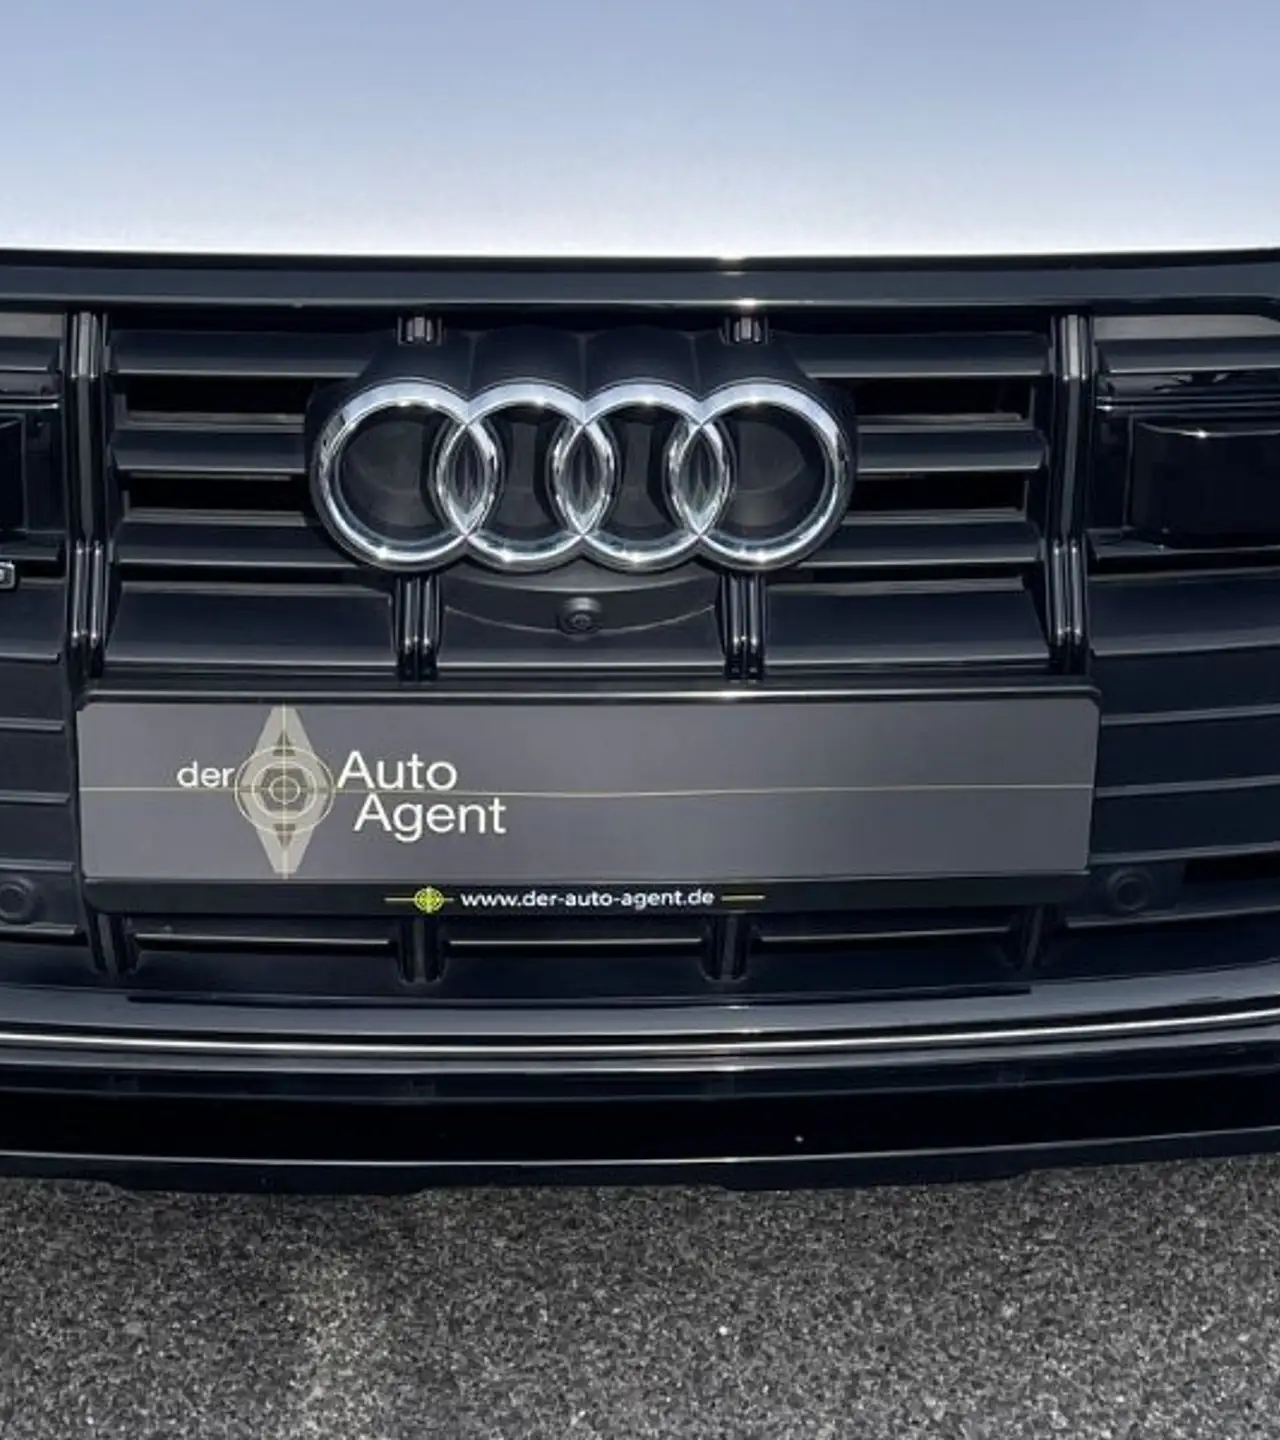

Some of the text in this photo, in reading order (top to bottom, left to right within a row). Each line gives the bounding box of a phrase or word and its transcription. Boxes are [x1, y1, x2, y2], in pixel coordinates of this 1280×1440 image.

[176, 749, 458, 791] der Auto
[353, 793, 507, 843] Agent
[459, 888, 716, 911] www.der-auto-agent.de
